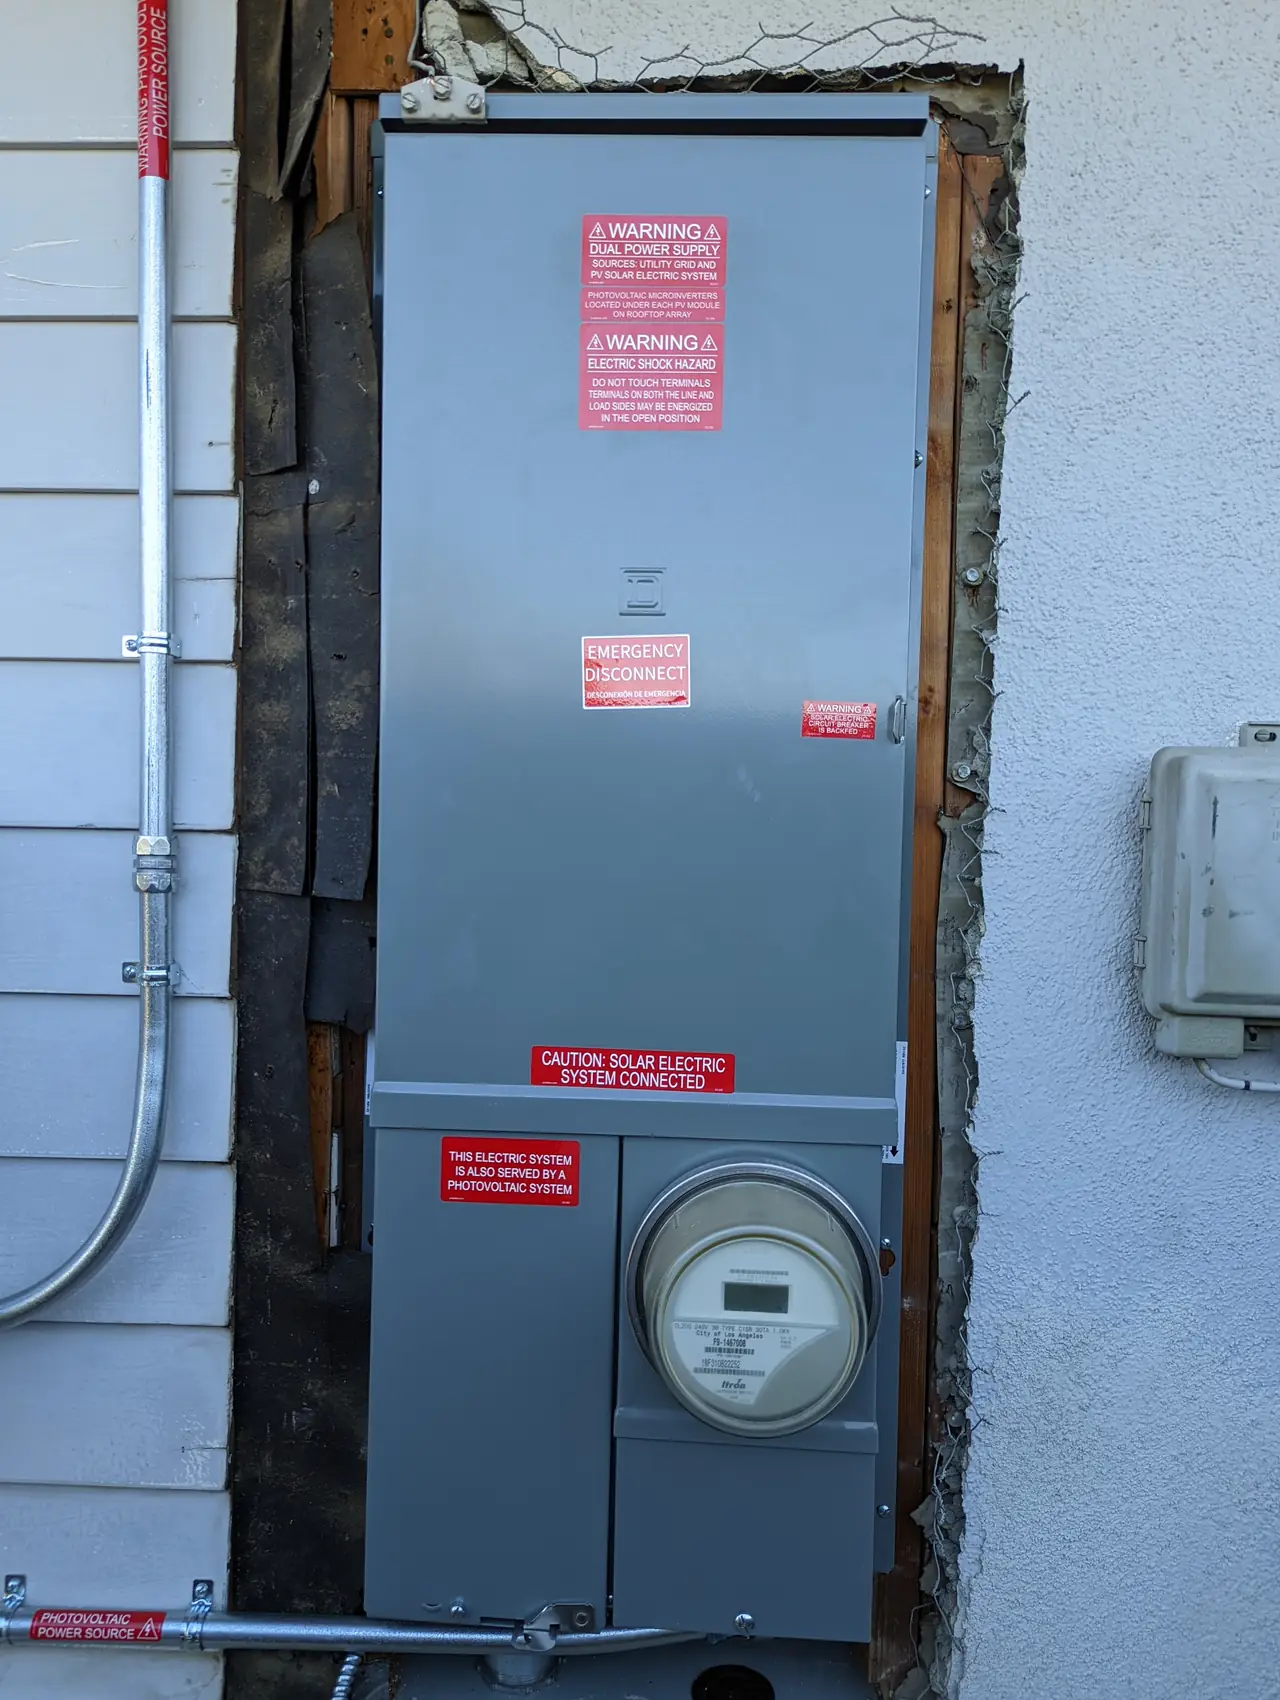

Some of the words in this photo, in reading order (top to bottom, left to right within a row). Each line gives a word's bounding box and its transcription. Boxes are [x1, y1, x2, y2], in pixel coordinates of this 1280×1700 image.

[150, 6, 167, 76] SOURCE
[152, 80, 168, 138] POWER
[608, 223, 701, 240] WARNING
[589, 244, 621, 255] DUAL
[625, 244, 670, 255] POWER
[673, 245, 720, 256] SUPPLY
[592, 260, 637, 268] SOURCES:
[640, 260, 671, 268] UTILITY
[674, 261, 696, 269] GRID
[697, 261, 716, 269] AND
[591, 271, 603, 279] PV
[605, 271, 633, 279] SOLAR
[636, 272, 679, 280] ELECTRIC
[681, 272, 717, 280] SYSTEM
[649, 292, 718, 300] MICROINVERTERS
[606, 335, 698, 350] WARNING
[588, 358, 635, 369] ELECTRIC
[638, 358, 673, 369] SHOCK
[675, 359, 716, 370] HAZARD
[592, 379, 605, 387] DO
[608, 379, 625, 387] NOT
[628, 379, 659, 387] TOUCH
[661, 379, 711, 387] TERMINALS
[589, 390, 629, 399] TERMINALS
[631, 391, 643, 399] ON
[644, 391, 664, 399] BOTH
[665, 391, 680, 399] THE
[682, 391, 698, 399] LINE
[699, 391, 714, 399] AND
[637, 403, 653, 411] MAY
[656, 403, 666, 411] BE
[668, 403, 713, 411] ENERGIZED
[601, 414, 610, 422] IN
[612, 414, 629, 422] THE
[632, 414, 656, 422] OPEN
[658, 414, 700, 423] POSITION
[588, 644, 683, 659] EMERGENCY
[586, 666, 686, 681] DISCONNECT
[587, 690, 632, 698] DESCONEXIÓN
[818, 704, 861, 713] WARNING
[542, 1050, 606, 1068] CAUTION:
[610, 1054, 654, 1070] SOLAR
[659, 1056, 726, 1073] ELECTRIC
[561, 1069, 616, 1086] SYSTEM
[620, 1072, 705, 1090] CONNECTED
[449, 1151, 473, 1162] THIS
[476, 1152, 526, 1164] ELECTRIC
[529, 1154, 572, 1166] SYSTEM
[455, 1166, 466, 1176] IS
[467, 1166, 494, 1177] ALSO
[498, 1168, 540, 1179] SERVED
[542, 1170, 556, 1179] BY
[558, 1170, 566, 1180] A
[448, 1180, 527, 1193] PHOTOVOLTAIC
[530, 1183, 572, 1194] SYSTEM
[722, 1379, 746, 1389] Itron
[40, 1612, 131, 1625] PHOTOVOLTAIC
[38, 1628, 82, 1638] POWER
[85, 1628, 135, 1639] SOURCE
